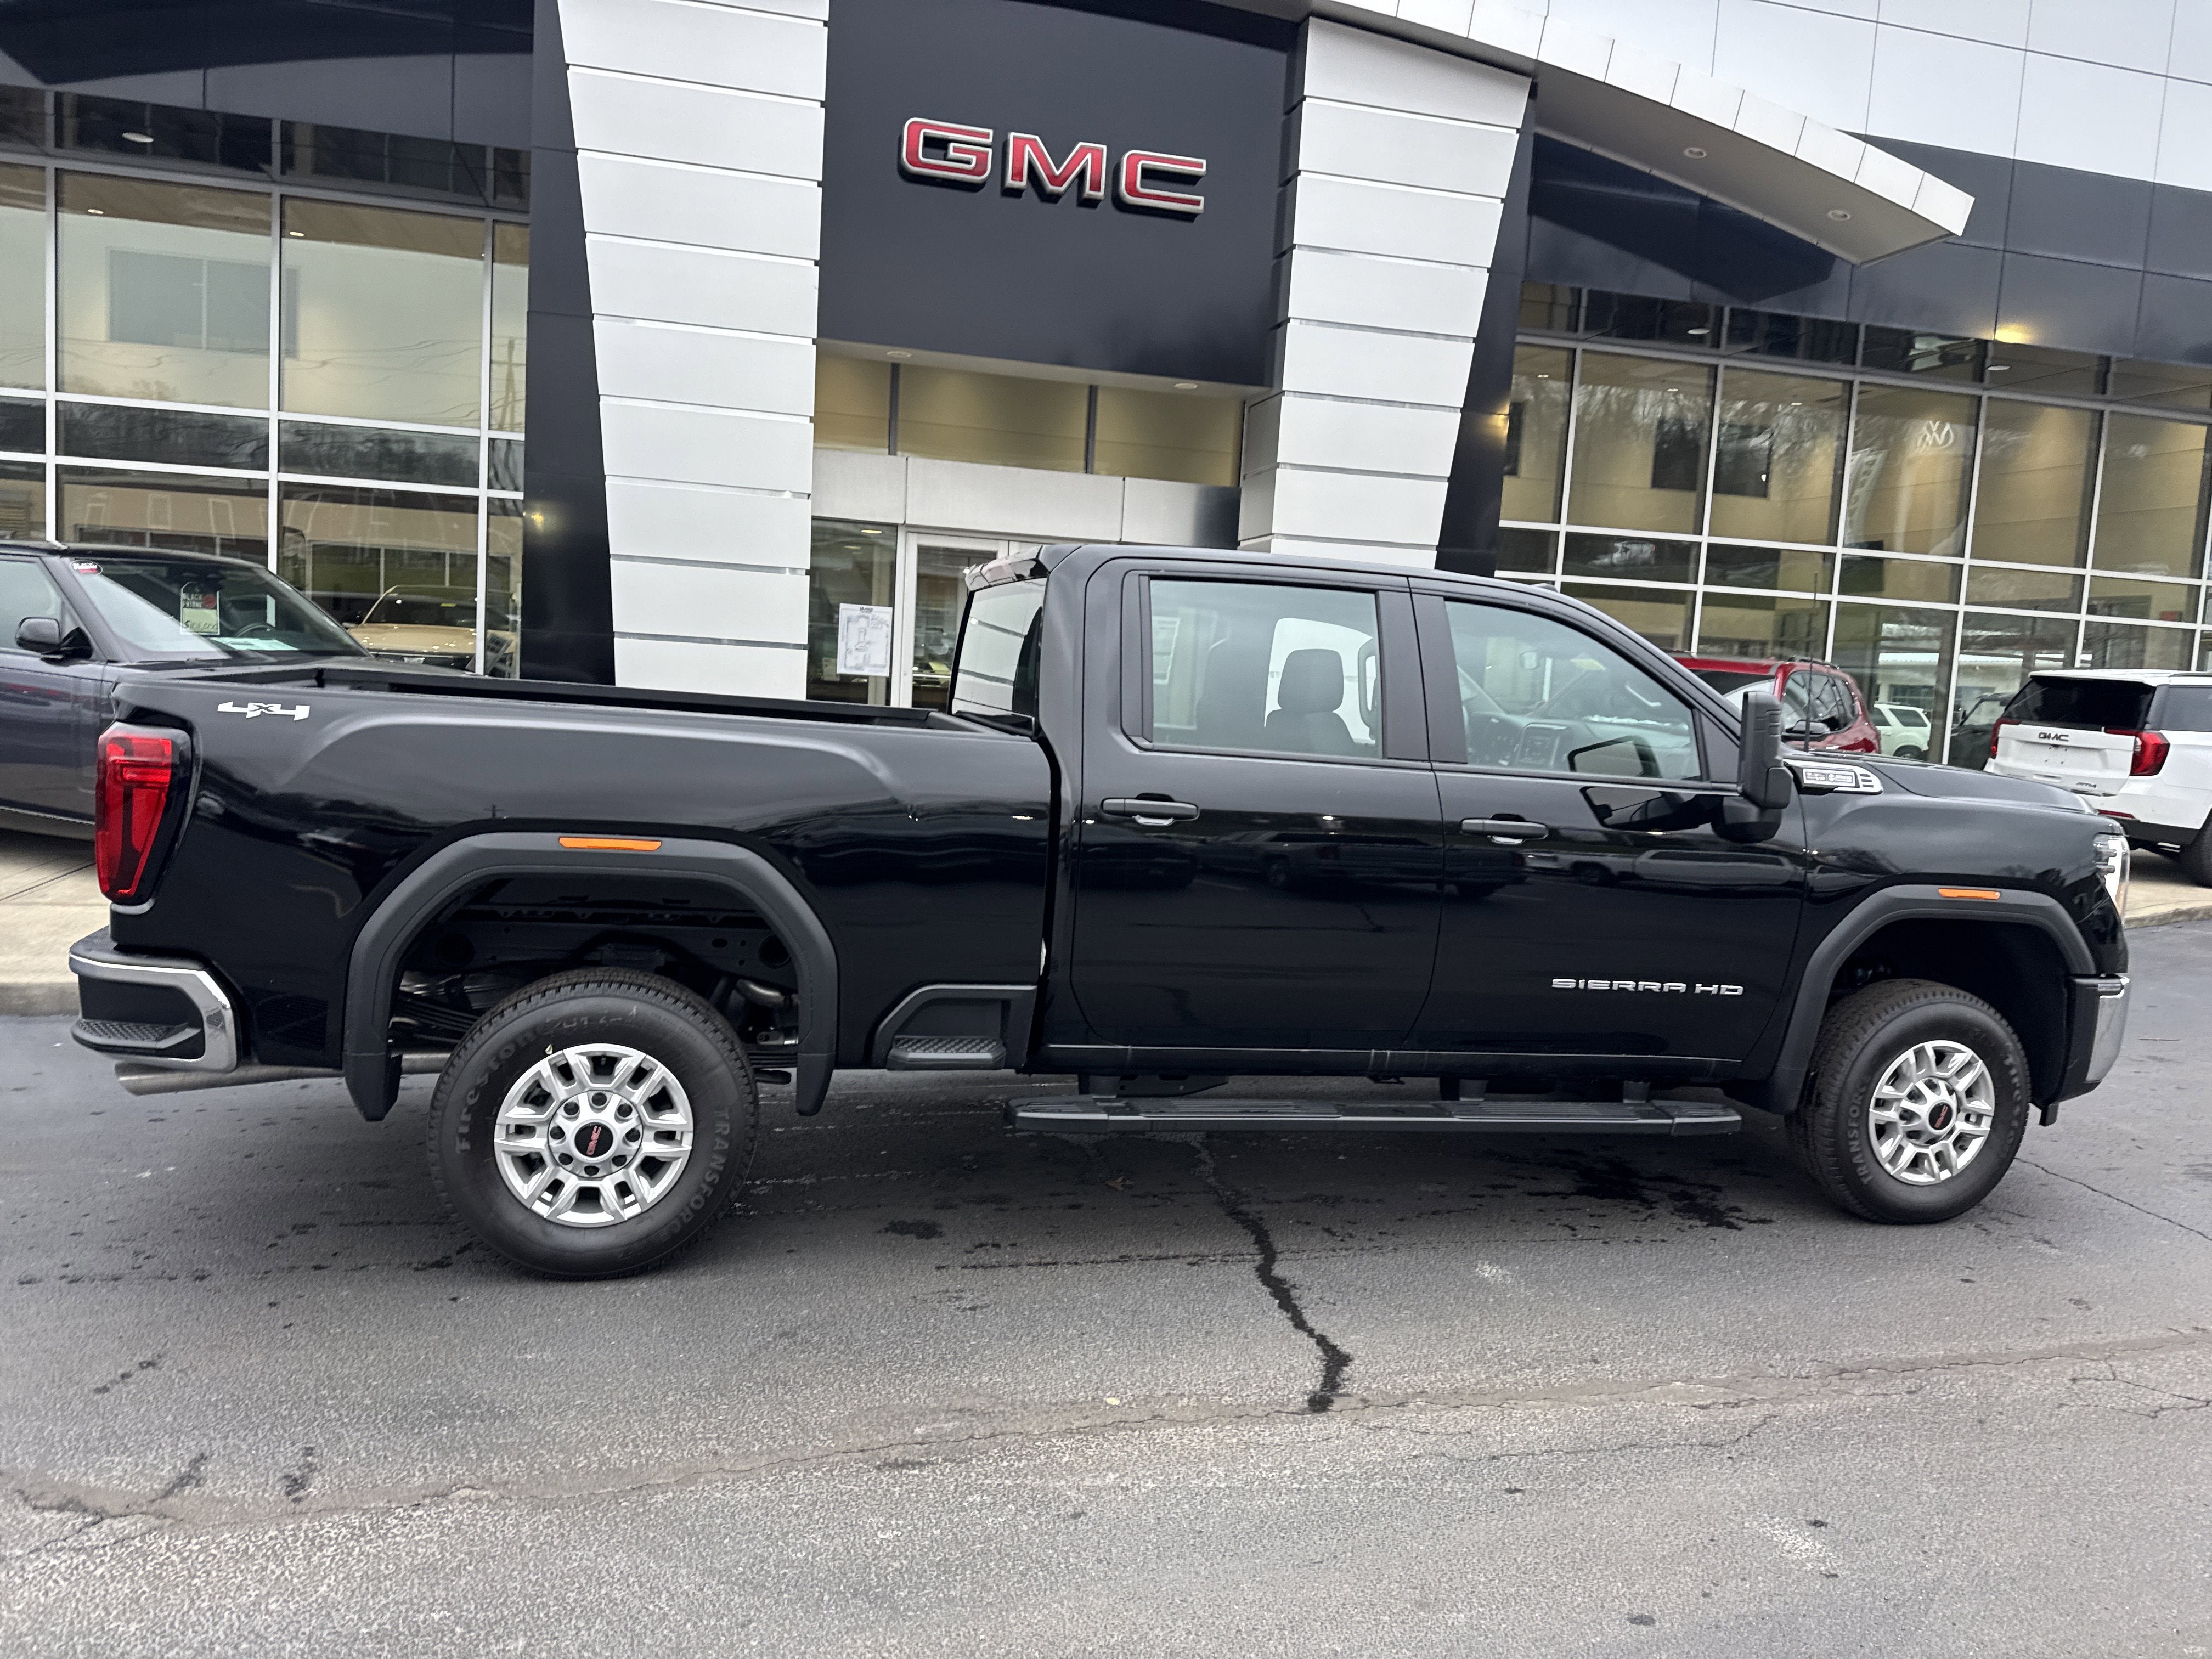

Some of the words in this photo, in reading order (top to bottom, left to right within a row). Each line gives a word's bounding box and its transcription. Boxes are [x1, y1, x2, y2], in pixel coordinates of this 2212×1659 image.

[901, 117, 1206, 215] GMC
[2038, 732, 2069, 742] GMC
[1551, 978, 1687, 994] SIERRA
[1694, 983, 1744, 996] HD
[586, 1126, 602, 1156] GMC
